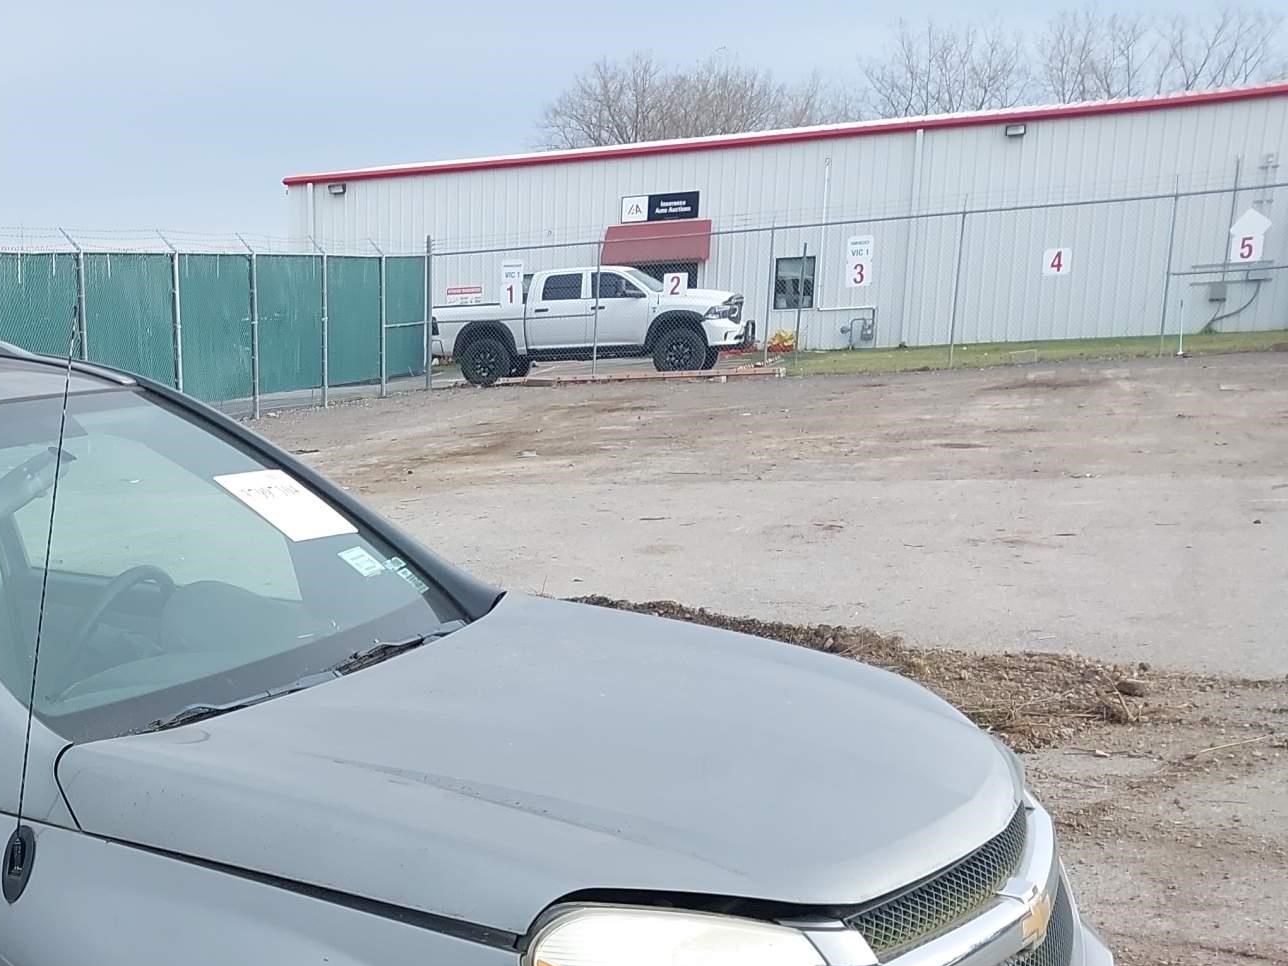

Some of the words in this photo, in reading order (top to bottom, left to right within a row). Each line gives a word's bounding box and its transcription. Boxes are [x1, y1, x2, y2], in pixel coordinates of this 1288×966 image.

[851, 248, 864, 257] VIC
[1239, 236, 1254, 259] 5
[1050, 250, 1063, 272] 4
[504, 271, 516, 279] VIC
[853, 263, 864, 285] 3
[506, 284, 514, 305] 1
[669, 275, 681, 296] 2
